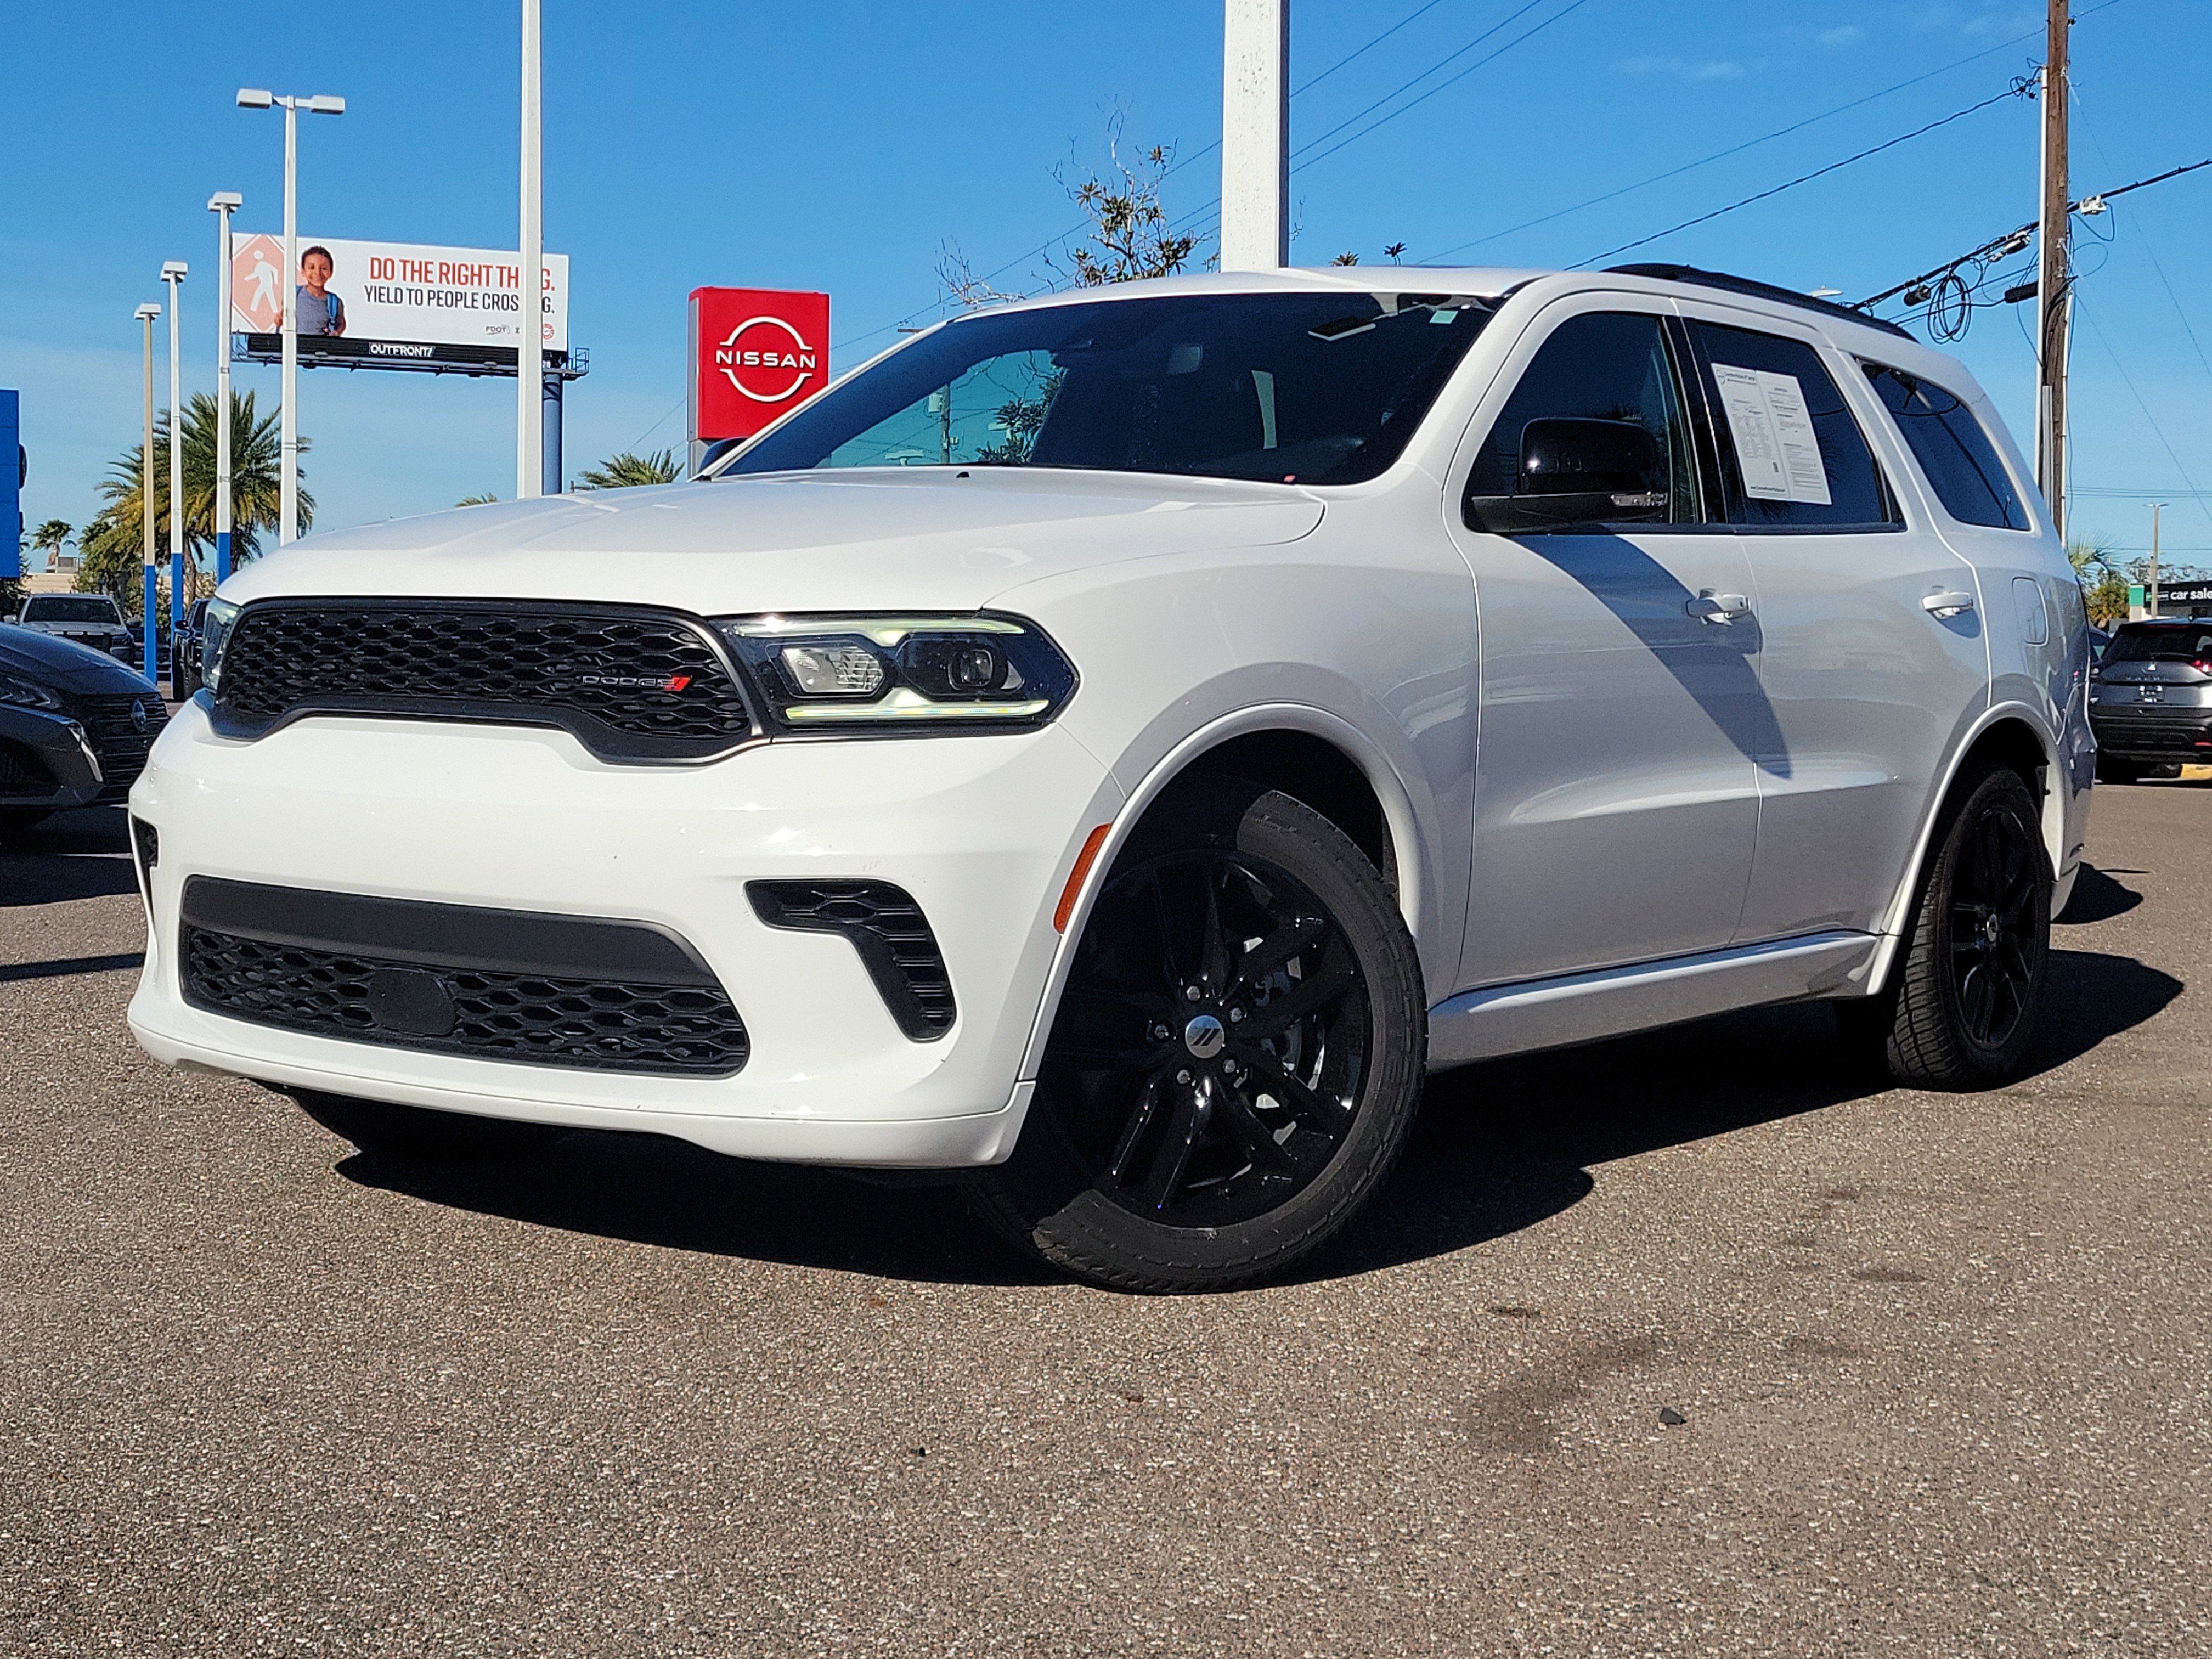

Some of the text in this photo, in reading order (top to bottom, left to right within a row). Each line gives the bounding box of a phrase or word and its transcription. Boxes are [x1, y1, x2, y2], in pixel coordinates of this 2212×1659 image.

[370, 257, 555, 291] DO THE RIGHT THG.
[364, 285, 555, 314] YIELD TO PEOPLE CROSG.
[716, 349, 816, 369] NISSAN
[2170, 591, 2188, 600] car
[582, 675, 675, 687] DODGE
